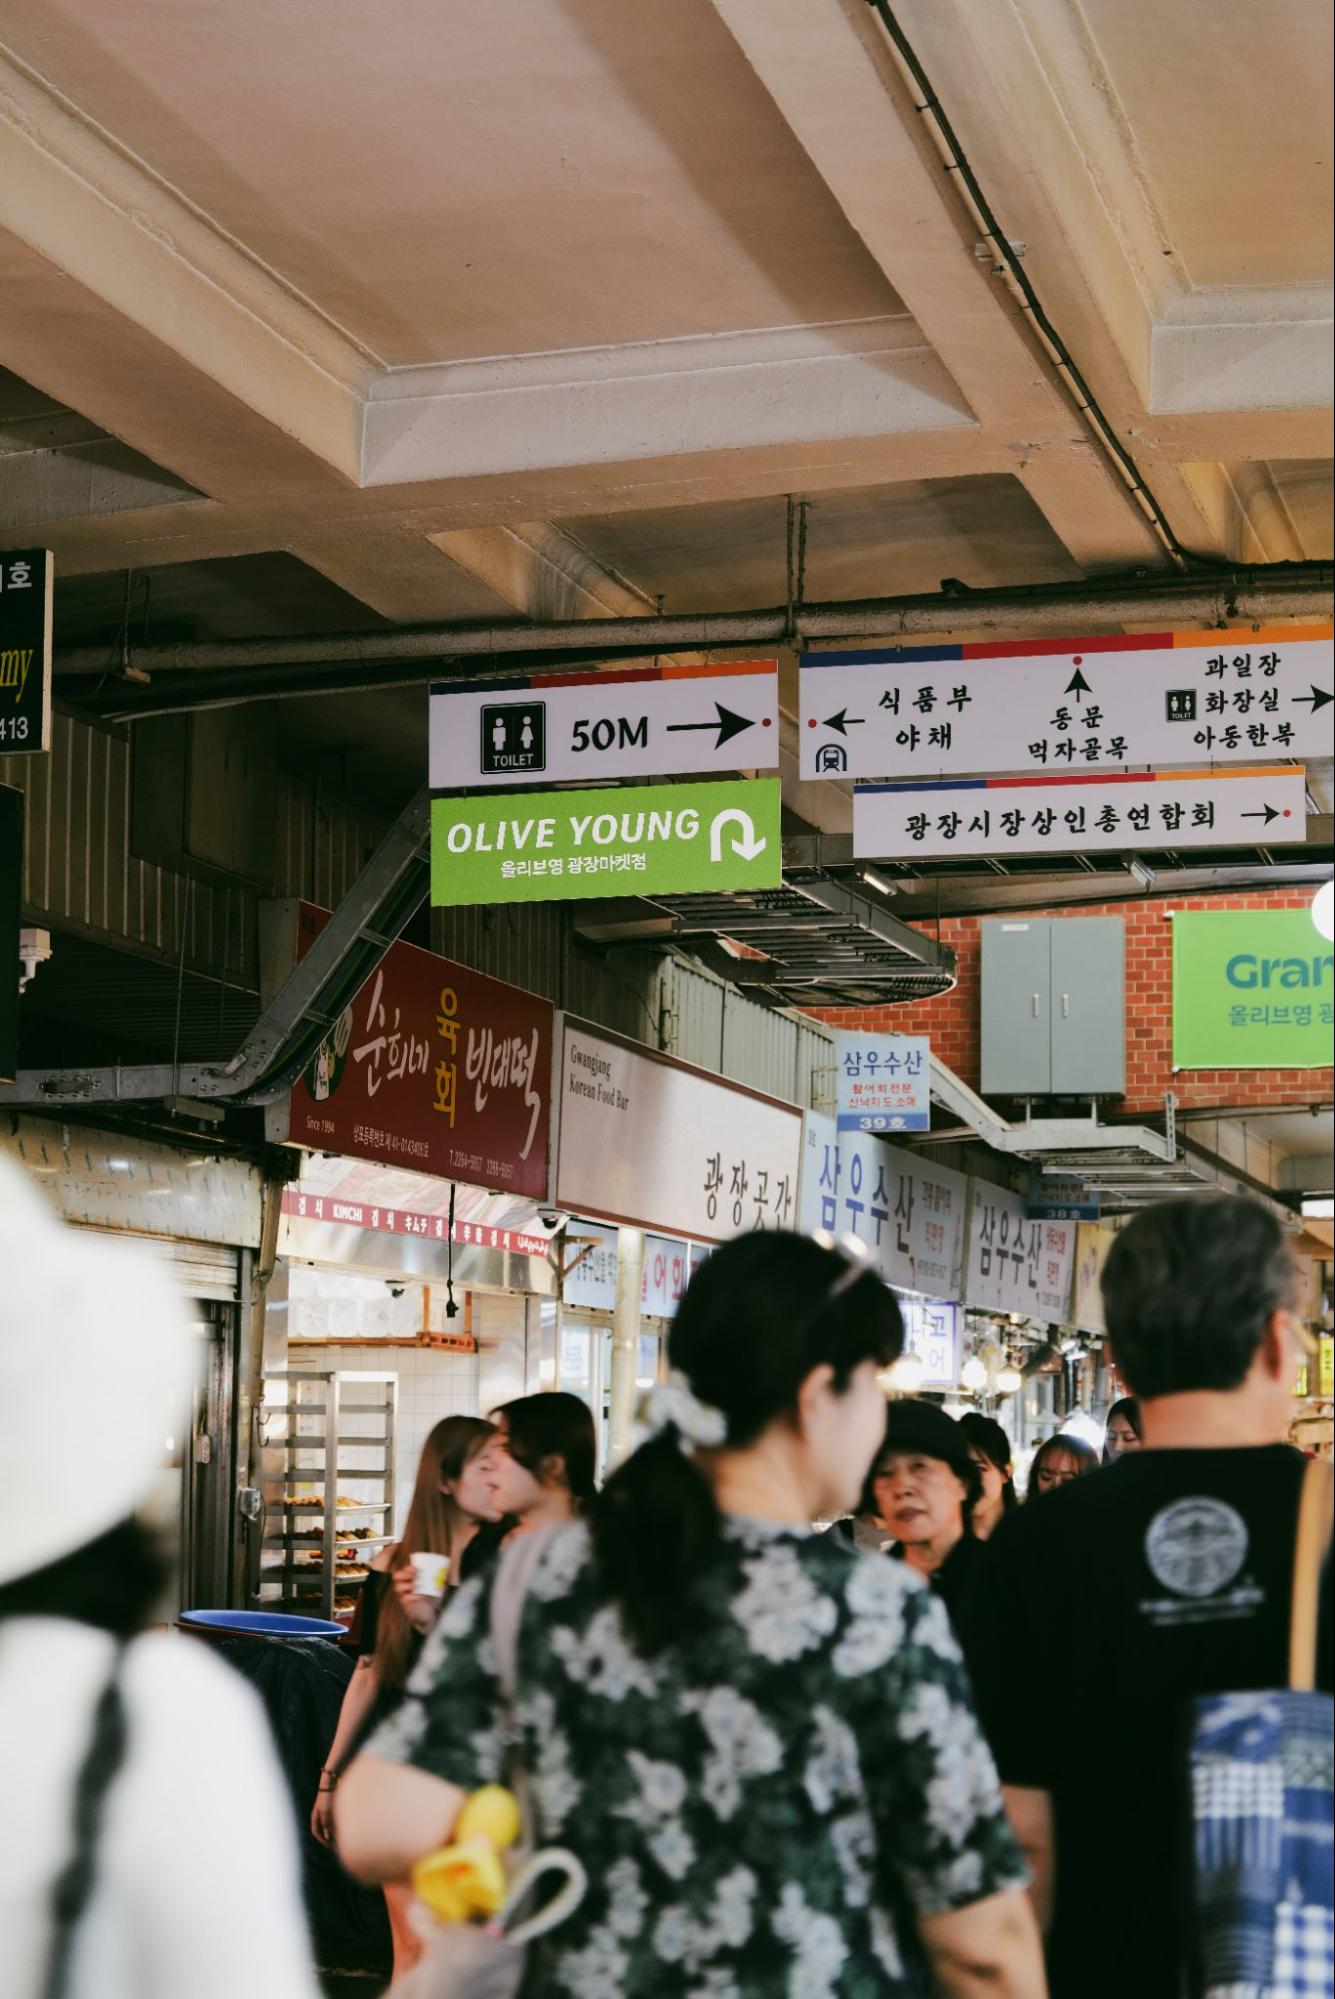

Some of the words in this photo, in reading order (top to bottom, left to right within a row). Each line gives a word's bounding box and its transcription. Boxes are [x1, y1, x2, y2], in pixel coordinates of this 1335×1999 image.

[0, 562, 32, 592] 호
[1204, 652, 1281, 679] 과일장
[878, 685, 972, 715] 식품부
[1204, 686, 1280, 714] 화장실
[1049, 706, 1104, 732] 동문
[571, 716, 649, 752] 50M
[895, 721, 953, 752] 야채
[1193, 721, 1295, 750] 아동한복
[493, 753, 534, 767] TOILET
[1027, 737, 1128, 763] 먹자골목
[447, 818, 556, 853] OLIVE
[570, 808, 700, 845] YOUNG
[904, 800, 1215, 841] 광장시장상인총연합회
[501, 858, 563, 879] 올리브영
[567, 853, 647, 874] 광장마켓점
[1229, 1004, 1311, 1026] 올리브영
[843, 1051, 923, 1077] 삼우수산
[465, 1027, 541, 1161] 빈대떡
[570, 1073, 596, 1100] Korean
[597, 1083, 615, 1106] Food
[616, 1090, 629, 1111] Bar
[306, 1115, 321, 1131] Since
[860, 1116, 907, 1130] 39호
[333, 1203, 362, 1222] KIMCHI
[819, 1145, 914, 1254] 삼우수산
[980, 1206, 1042, 1289] 삼우수산
